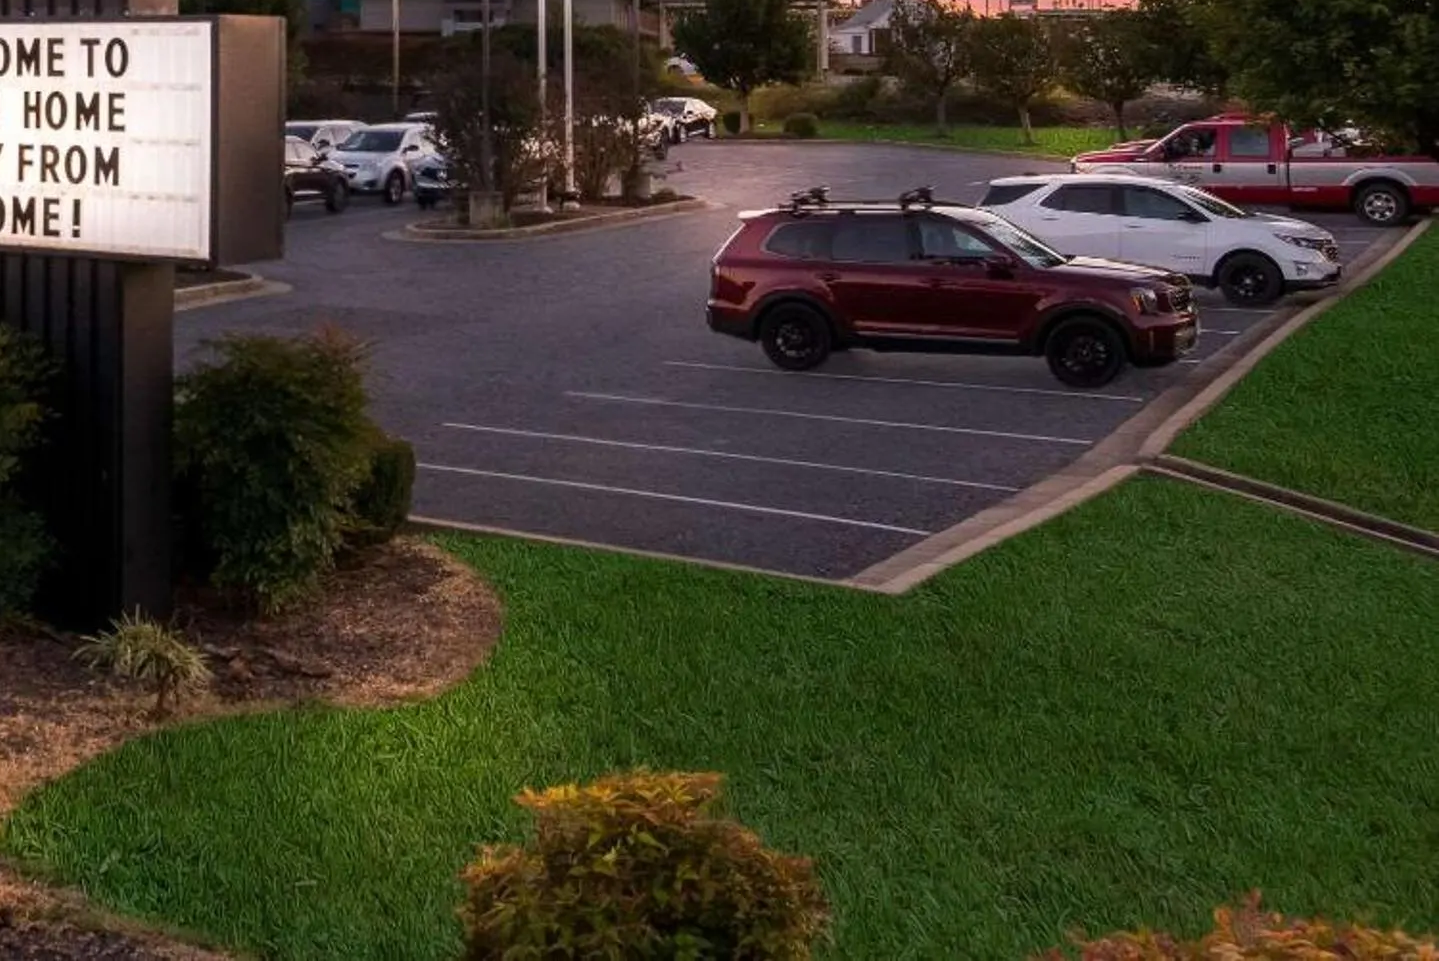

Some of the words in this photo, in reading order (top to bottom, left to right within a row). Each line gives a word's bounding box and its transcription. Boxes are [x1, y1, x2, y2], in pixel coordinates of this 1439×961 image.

[79, 38, 129, 77] TO
[23, 91, 126, 132] HOME
[18, 144, 120, 186] FROM
